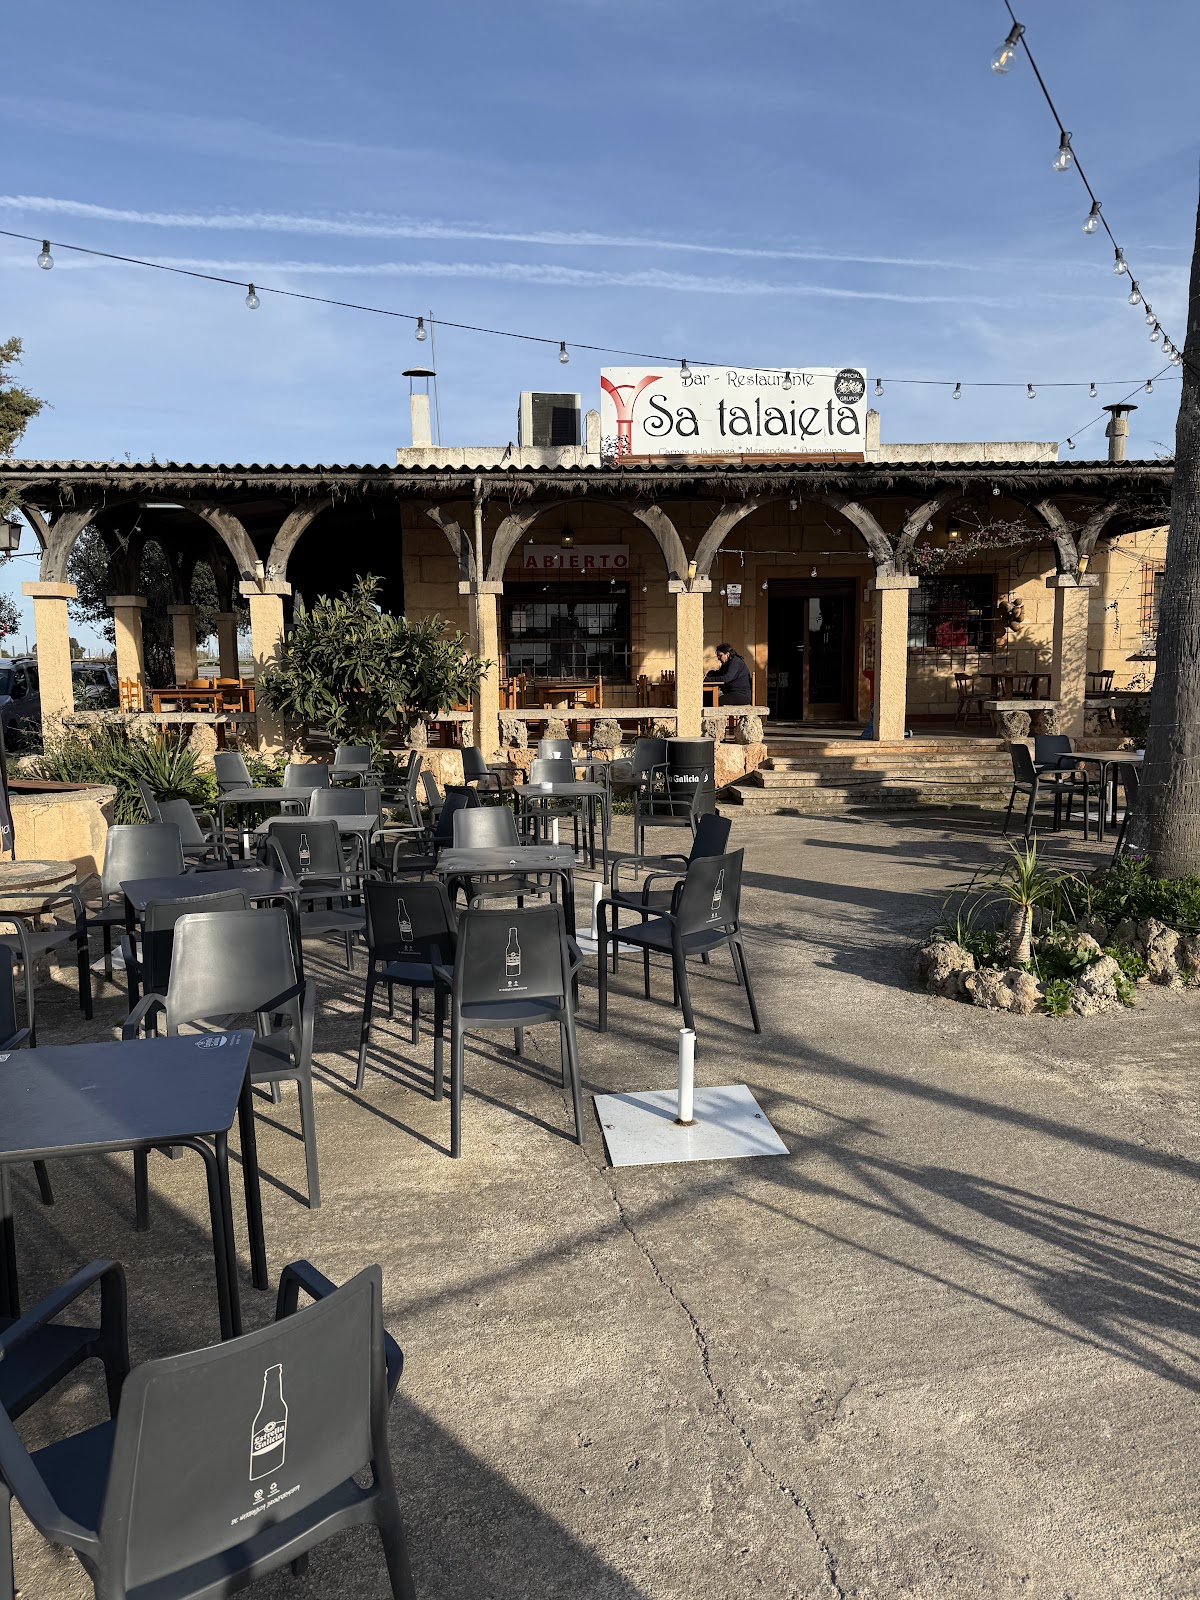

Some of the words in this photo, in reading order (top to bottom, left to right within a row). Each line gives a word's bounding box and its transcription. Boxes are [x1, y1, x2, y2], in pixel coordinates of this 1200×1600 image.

[726, 370, 815, 388] Restaurnte
[643, 394, 699, 437] Sa
[716, 397, 860, 441] talaieta
[525, 555, 629, 568] ABIERTO
[673, 774, 700, 783] Galicia
[254, 1425, 285, 1443] Estrella
[254, 1432, 283, 1450] Galicia
